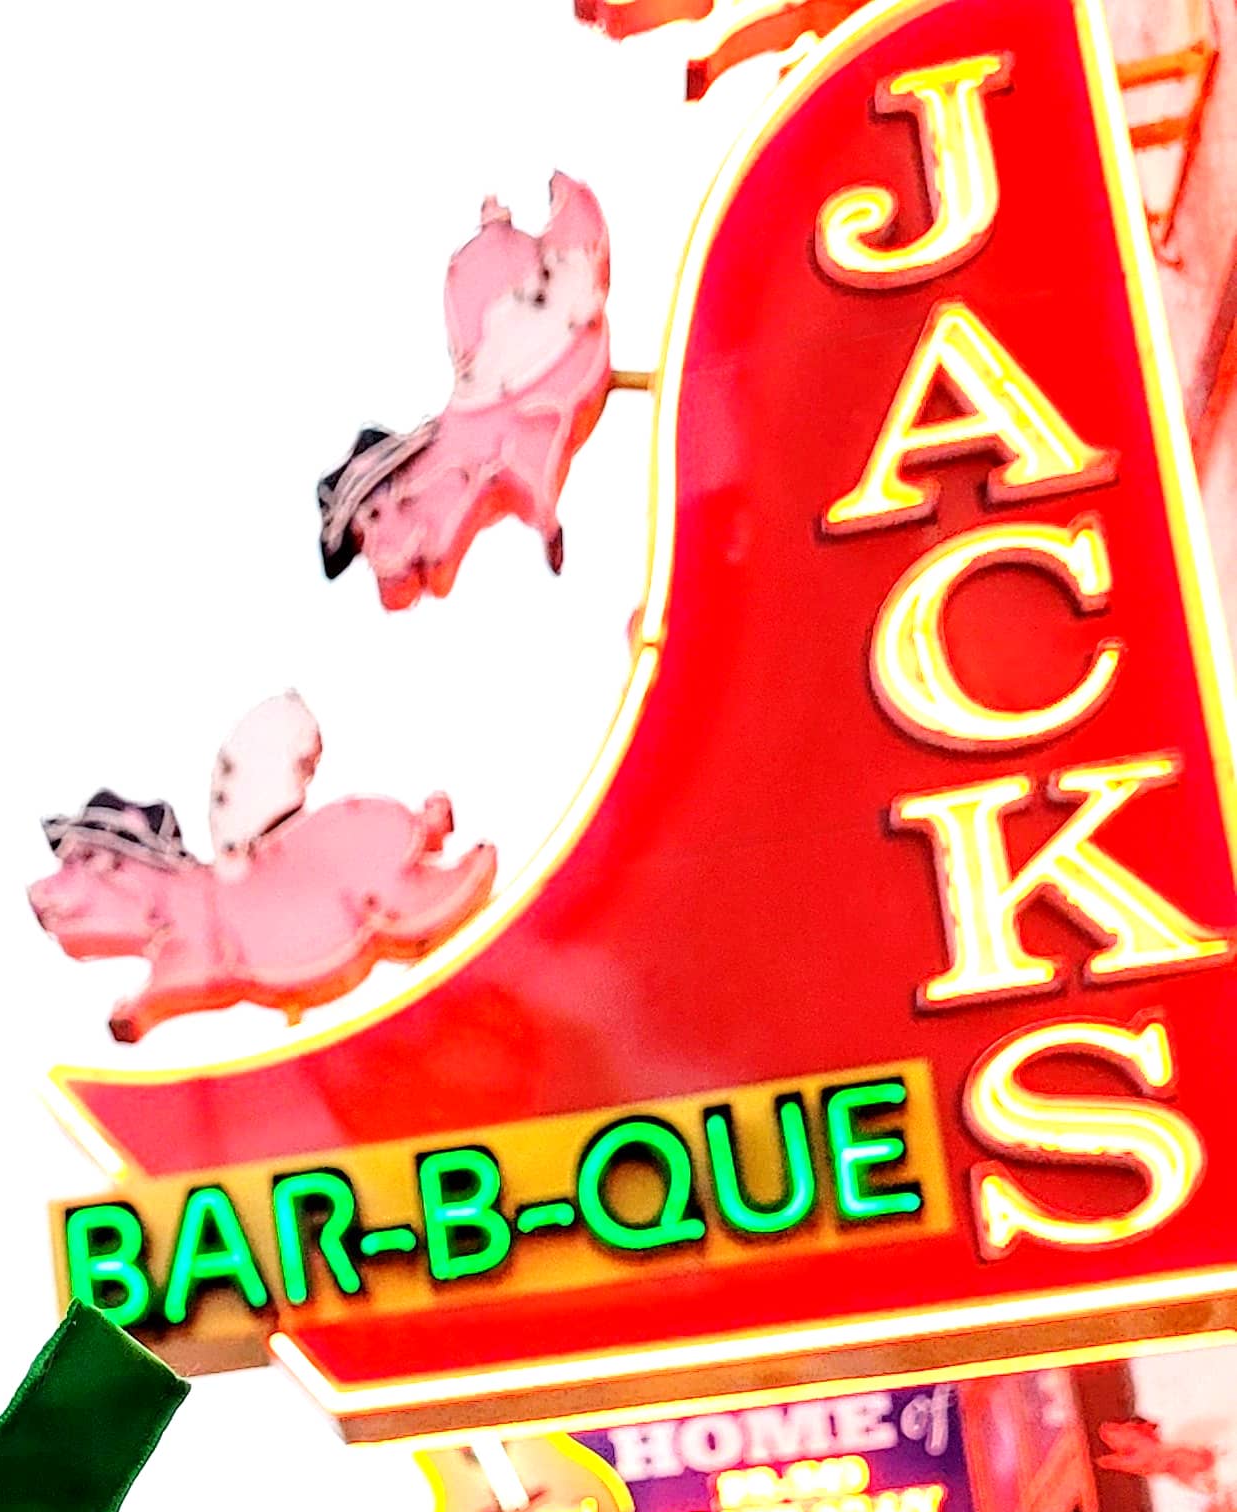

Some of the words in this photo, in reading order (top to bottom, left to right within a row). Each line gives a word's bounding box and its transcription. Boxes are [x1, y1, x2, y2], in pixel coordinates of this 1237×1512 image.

[815, 52, 1231, 1262] JACKS
[65, 1081, 921, 1330] BAR-B-QUE
[609, 1392, 898, 1481] HOME
[901, 1384, 958, 1456] of
